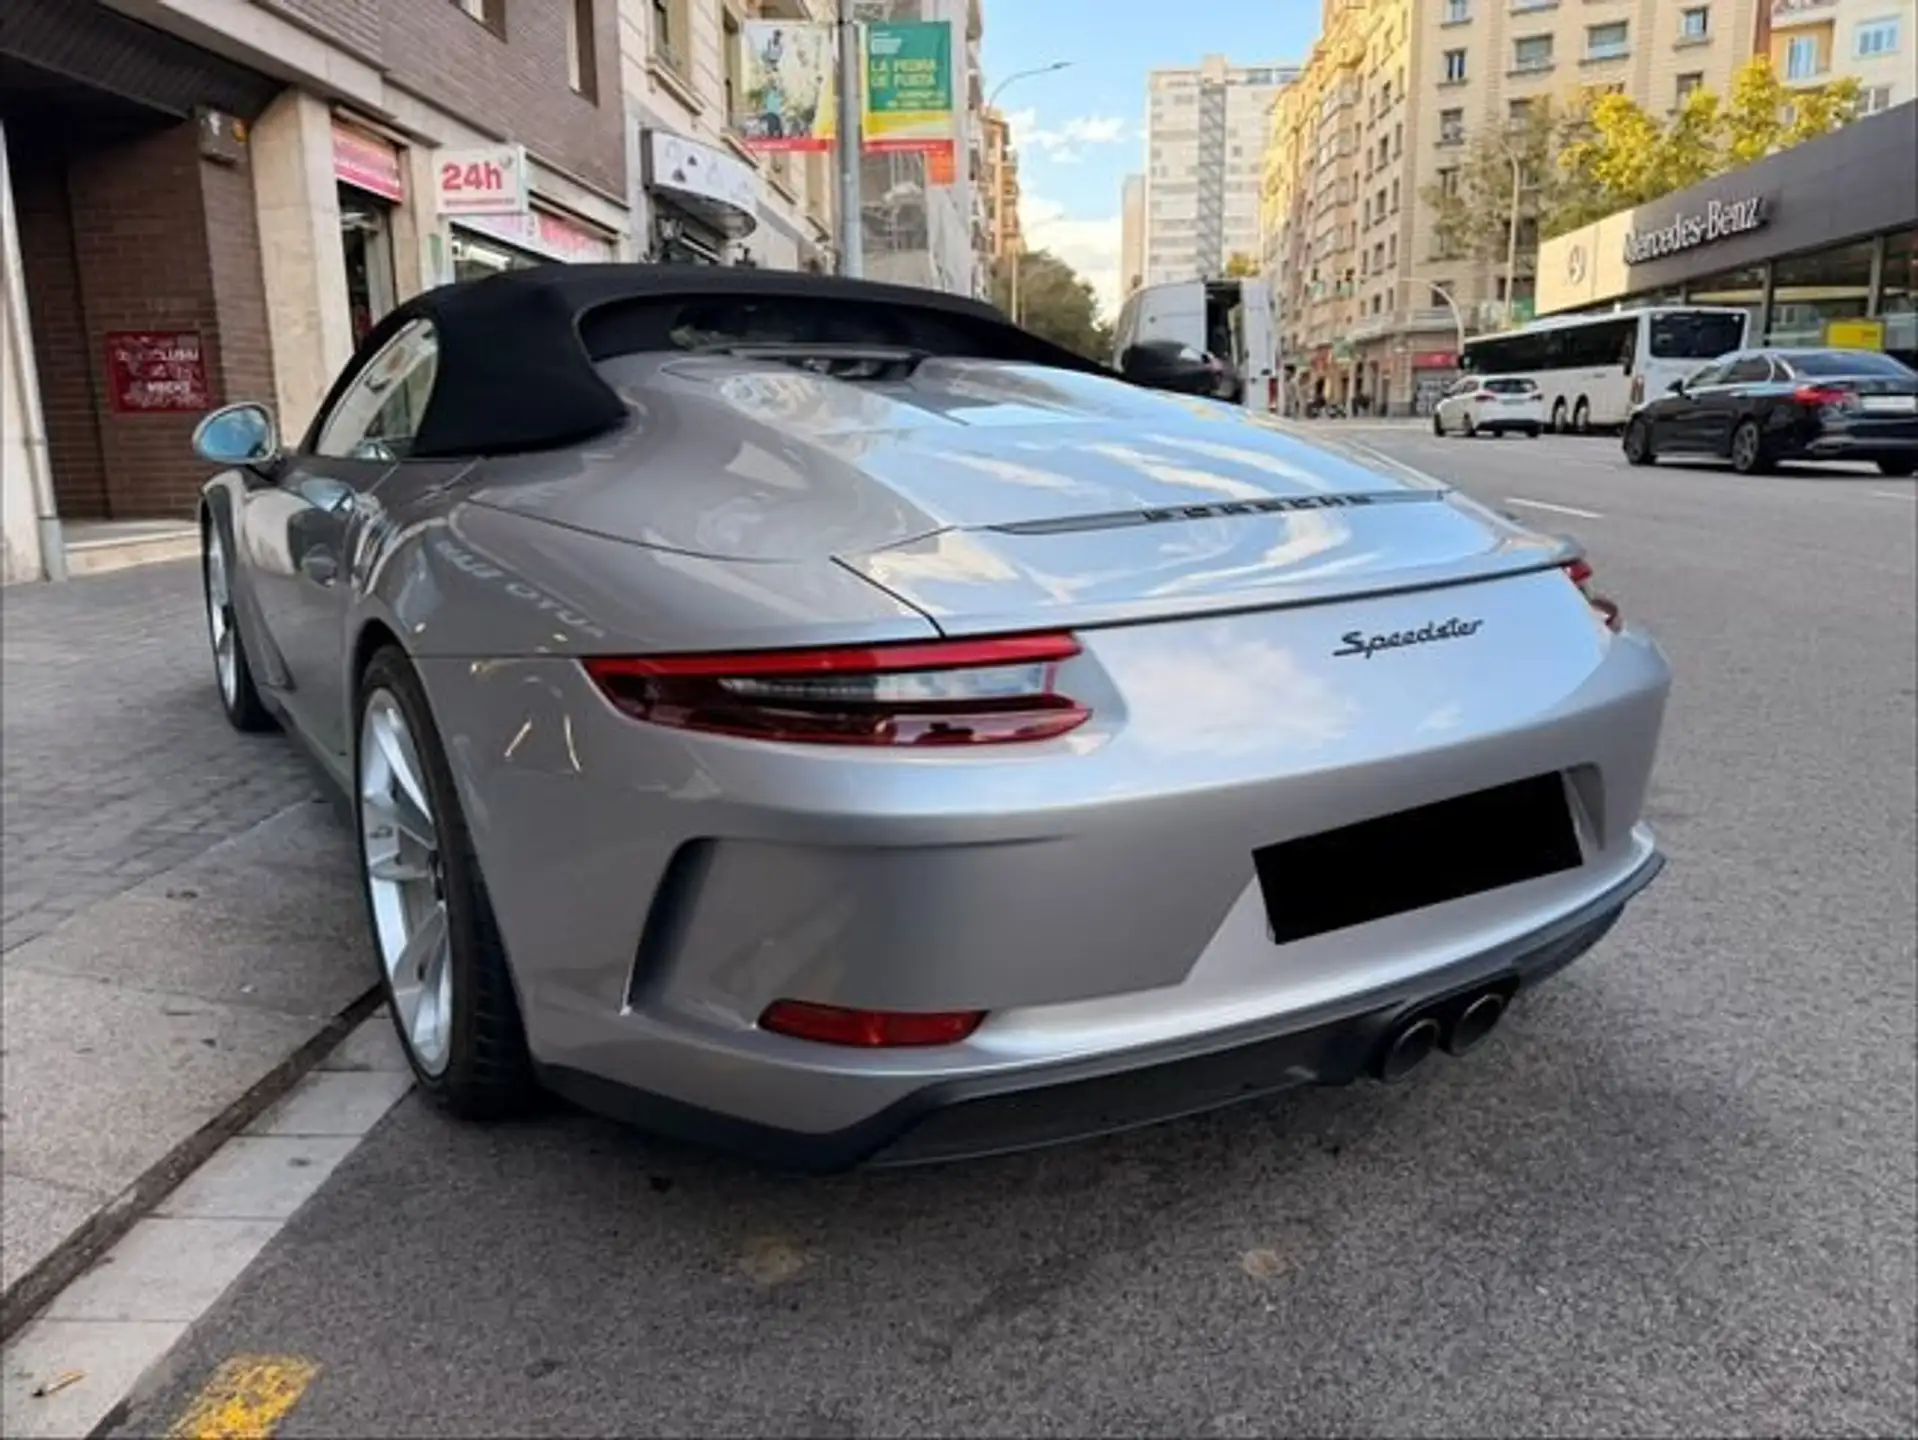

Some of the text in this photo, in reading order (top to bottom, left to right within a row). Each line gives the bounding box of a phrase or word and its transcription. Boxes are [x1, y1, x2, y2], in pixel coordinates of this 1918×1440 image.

[441, 160, 503, 191] 24h
[1624, 196, 1762, 264] Mercedes-Benz
[1332, 616, 1485, 660] Speedster
